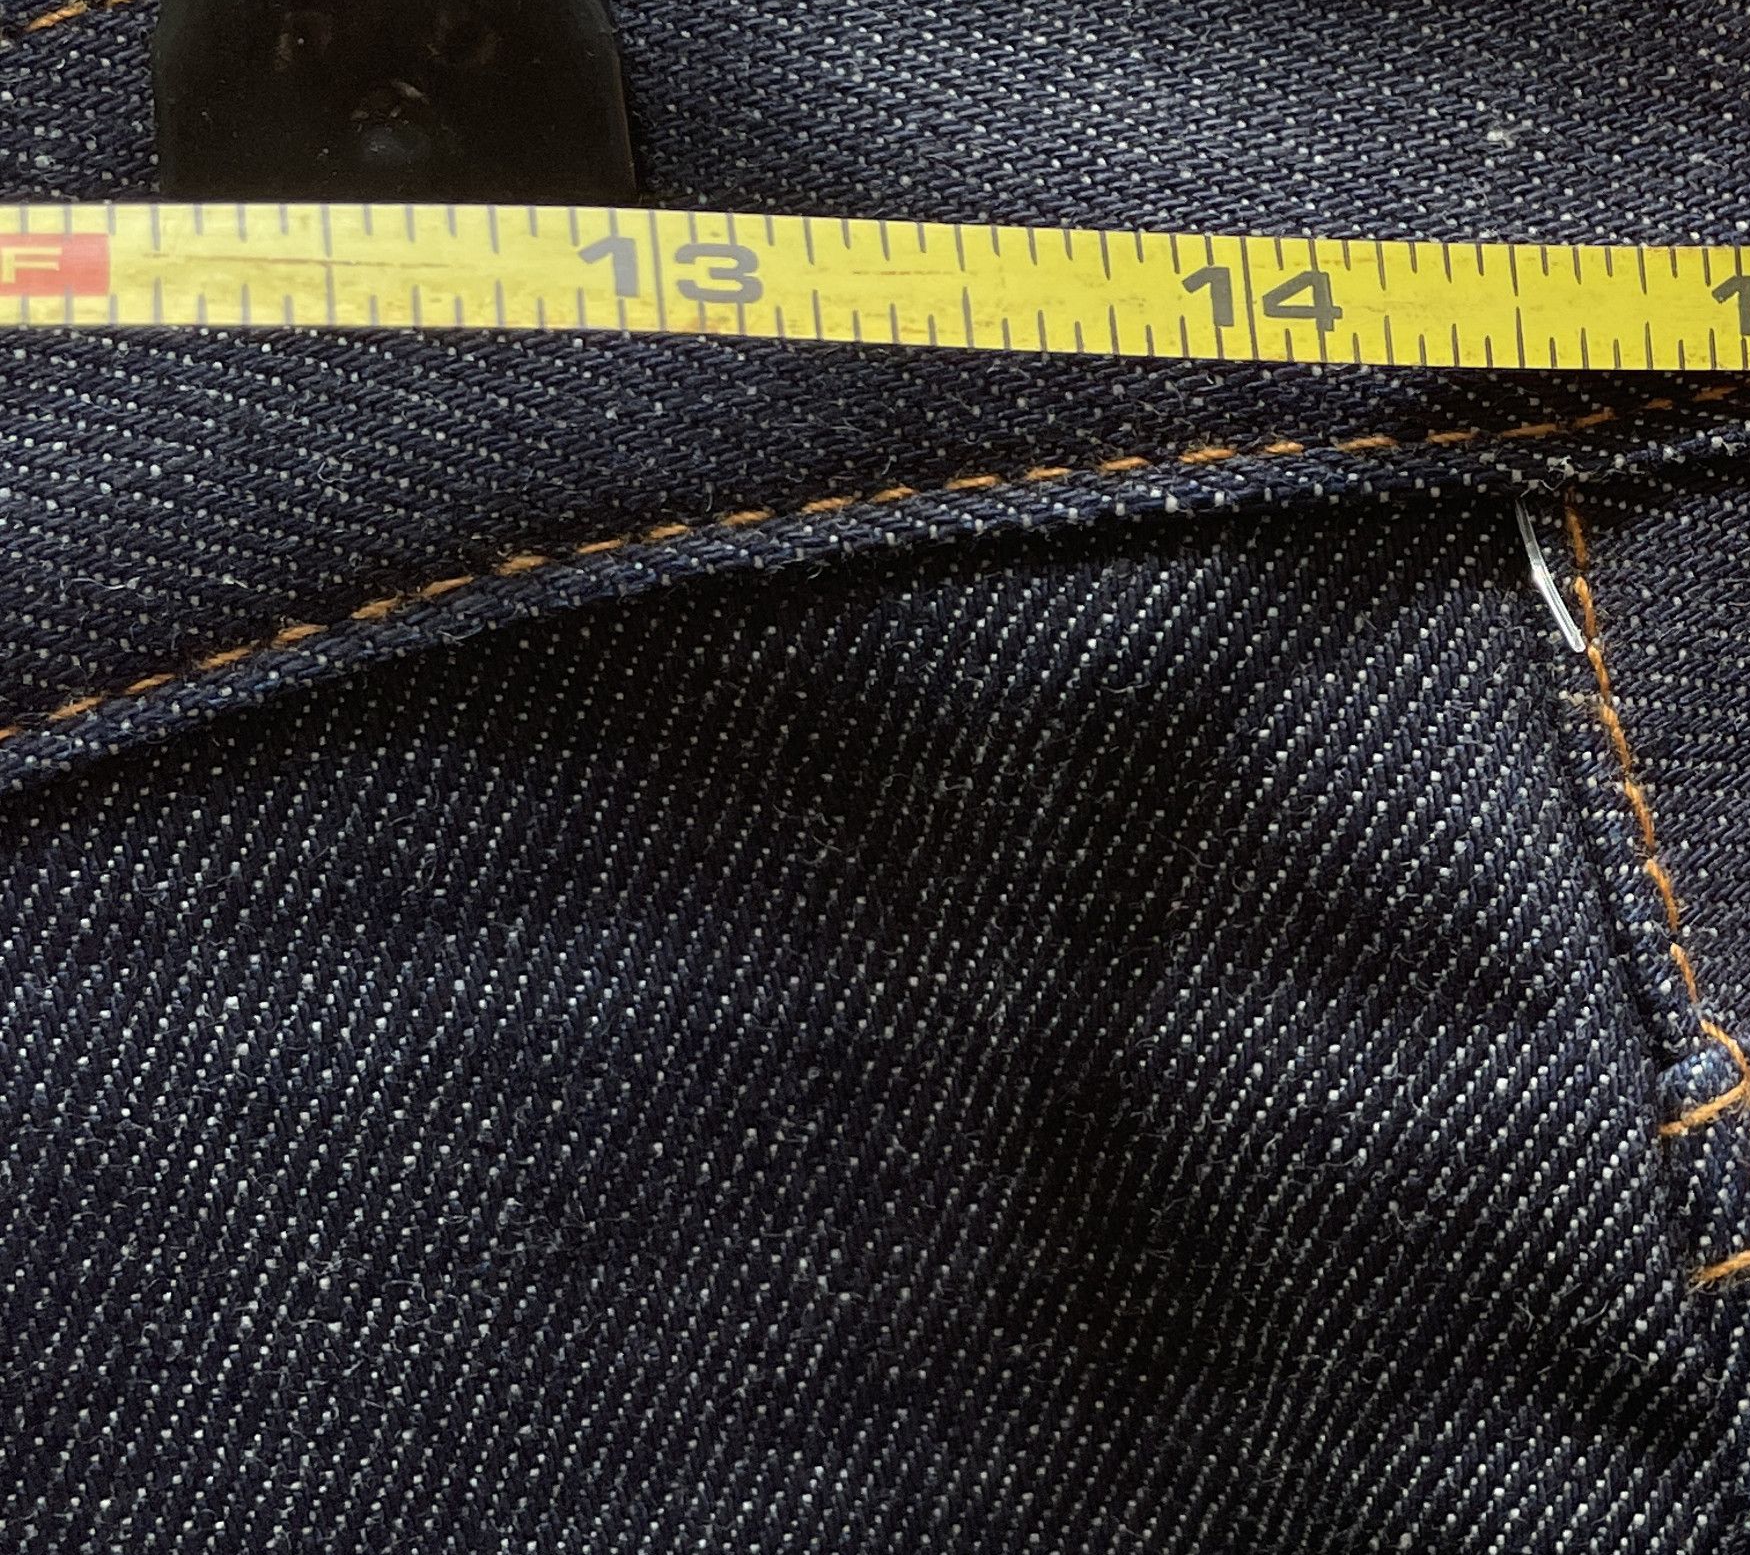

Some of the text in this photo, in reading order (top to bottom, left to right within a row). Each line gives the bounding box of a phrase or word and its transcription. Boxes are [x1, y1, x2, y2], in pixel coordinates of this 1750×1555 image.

[1, 246, 62, 284] F
[579, 236, 762, 304] 13
[1181, 266, 1343, 333] 14
